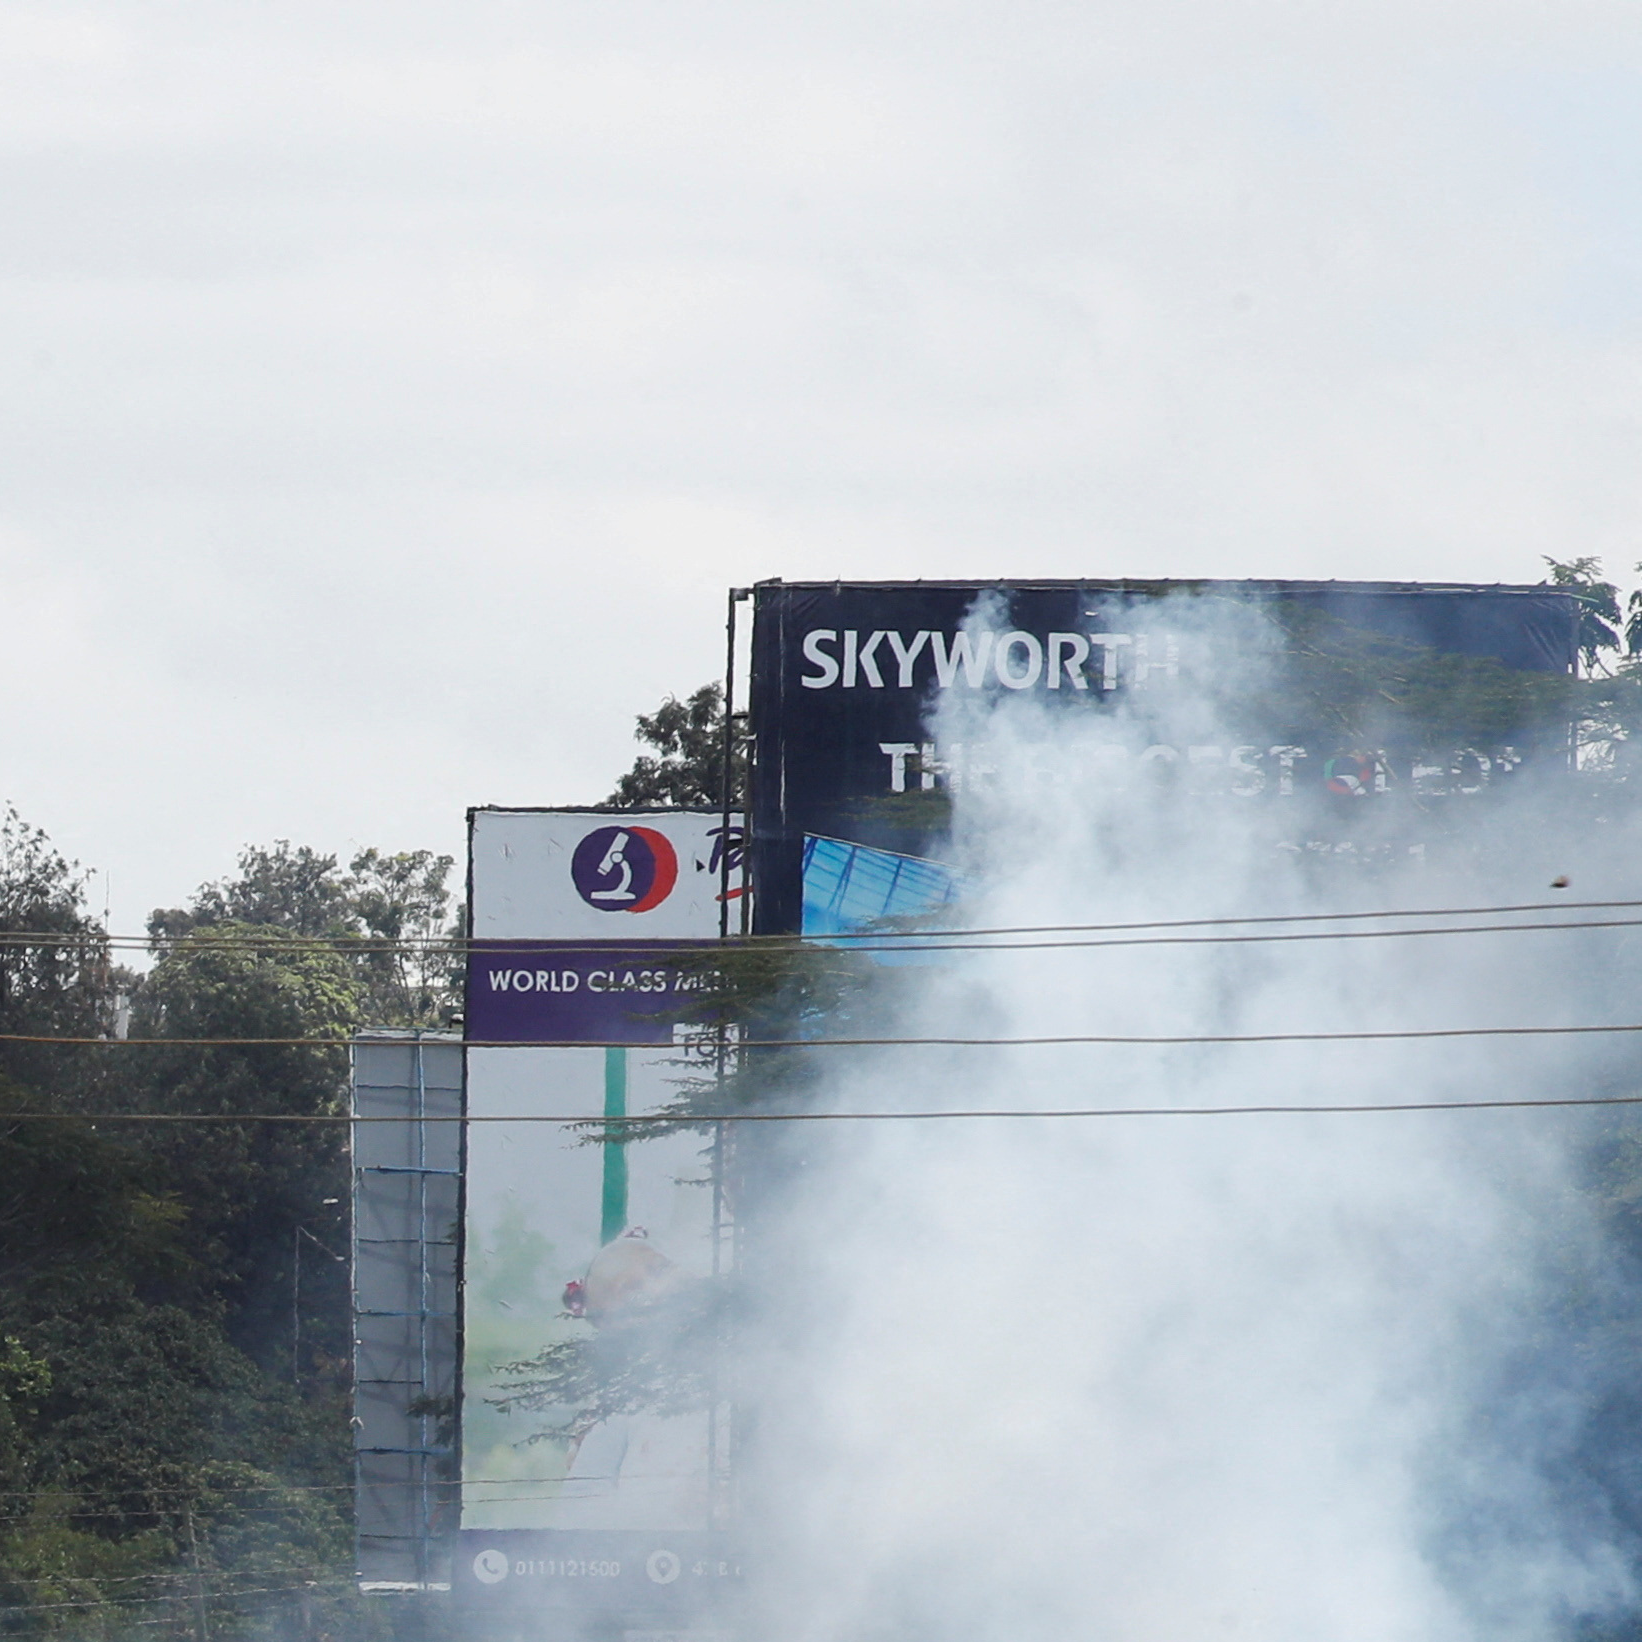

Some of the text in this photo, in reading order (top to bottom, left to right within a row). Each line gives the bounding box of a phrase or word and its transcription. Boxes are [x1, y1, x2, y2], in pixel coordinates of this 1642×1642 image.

[801, 628, 1179, 691] SKYWORTH
[489, 970, 580, 993] WORLD
[588, 970, 666, 992] CLASS
